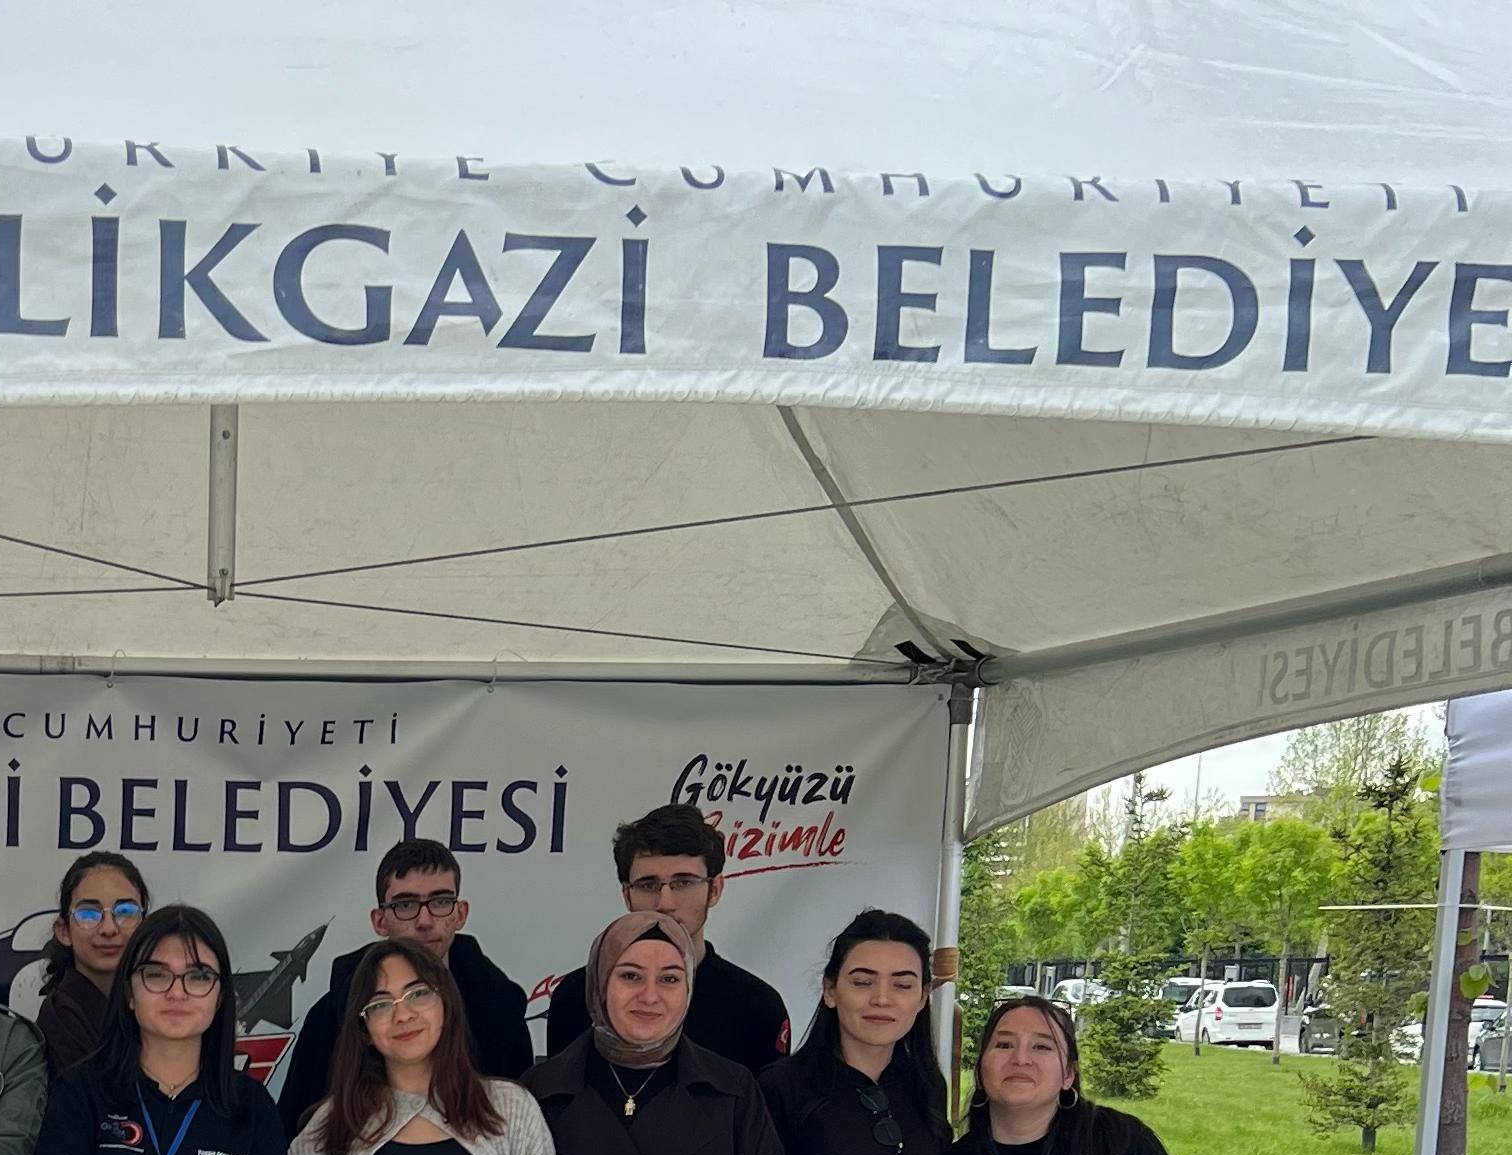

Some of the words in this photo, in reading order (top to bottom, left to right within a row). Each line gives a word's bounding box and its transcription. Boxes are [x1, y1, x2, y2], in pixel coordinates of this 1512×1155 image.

[763, 225, 1512, 377] BELEDİYE
[3, 712, 399, 746] CUMHURİYETİ
[57, 764, 569, 854] BELEDİYESİ
[670, 753, 856, 824] Gökyüzü
